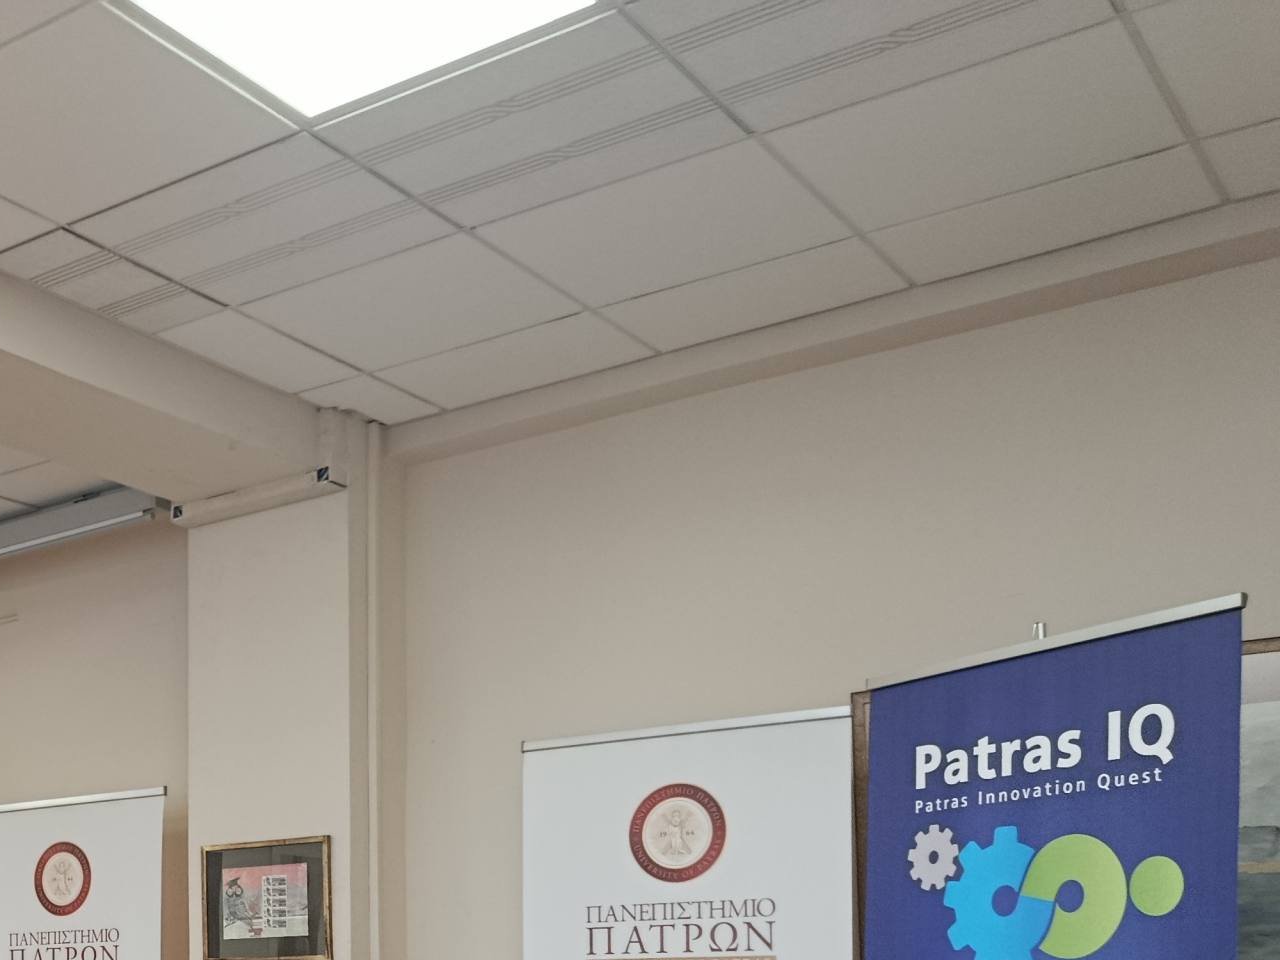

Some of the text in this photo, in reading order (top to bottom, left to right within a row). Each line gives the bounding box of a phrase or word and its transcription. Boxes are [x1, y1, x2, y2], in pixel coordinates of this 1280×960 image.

[915, 703, 1175, 790] Patras IQ
[915, 767, 1163, 814] Patras Innovation Quest
[585, 897, 776, 923] ΠΑΝΕΠΙΣΤΗΜΙΟ
[9, 928, 119, 947] ΠΑΝΕΠΙΣΤΗΜΙΟ
[586, 921, 776, 956] ΠΑΤΡΩΝ
